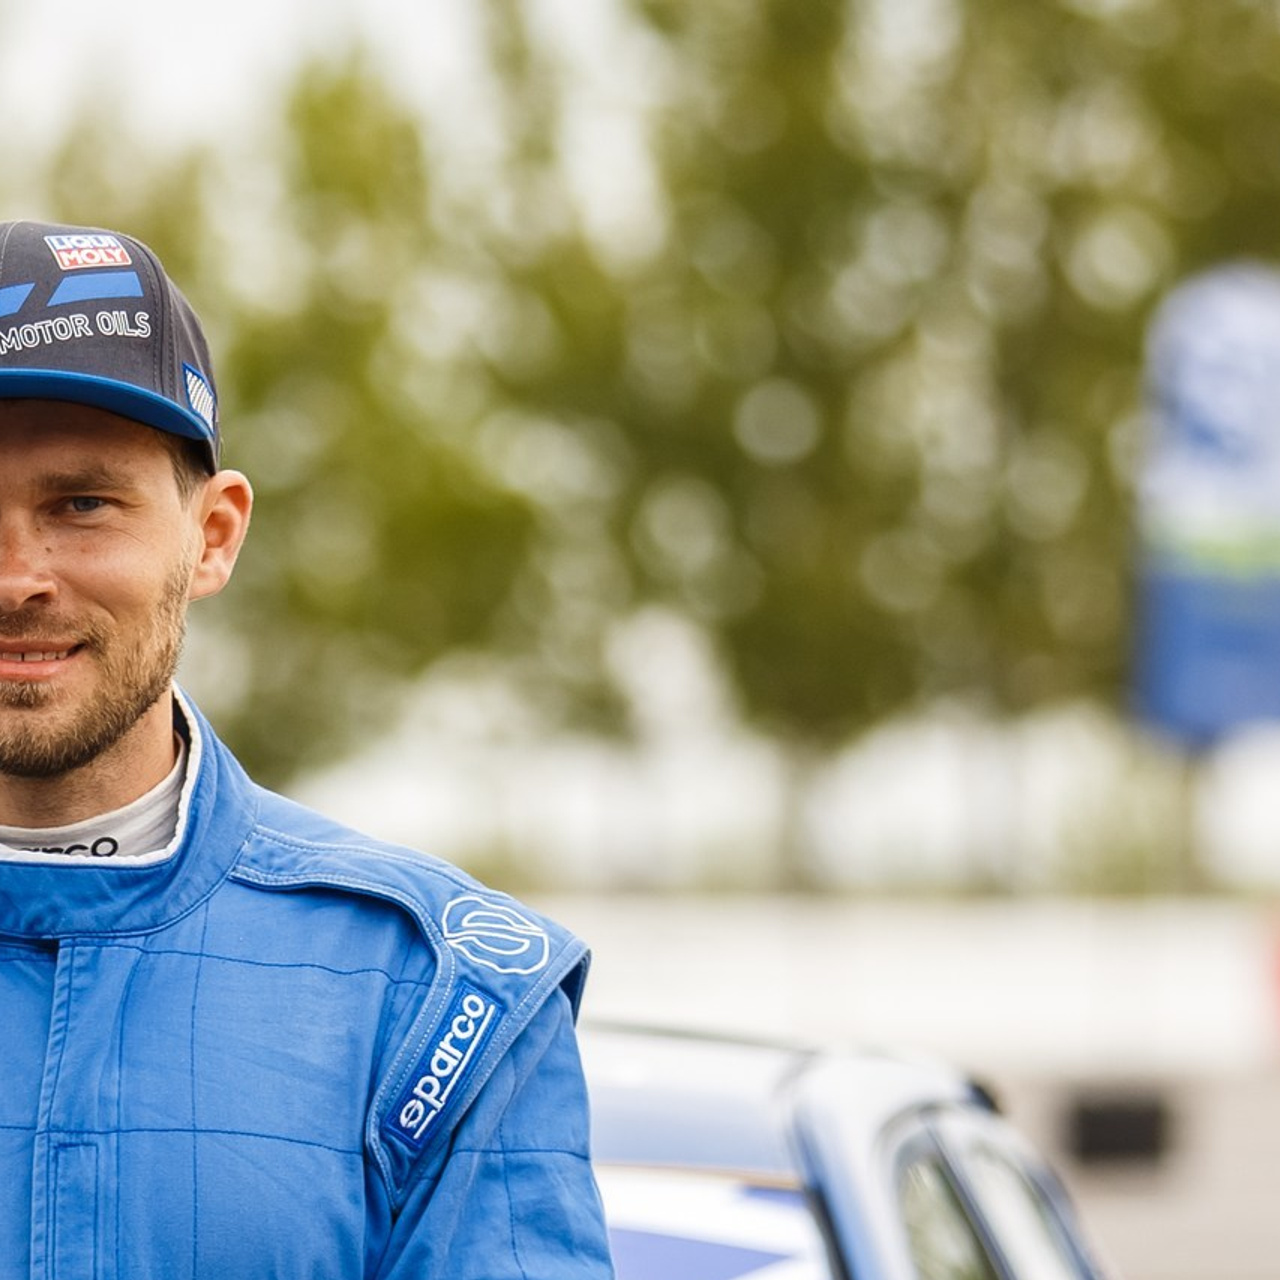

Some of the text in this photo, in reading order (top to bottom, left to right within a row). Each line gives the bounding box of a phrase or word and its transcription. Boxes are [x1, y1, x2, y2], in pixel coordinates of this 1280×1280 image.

[49, 235, 118, 250] LIQUI
[57, 249, 124, 266] MOLY
[96, 310, 152, 339] OILS
[399, 993, 487, 1129] sparco
